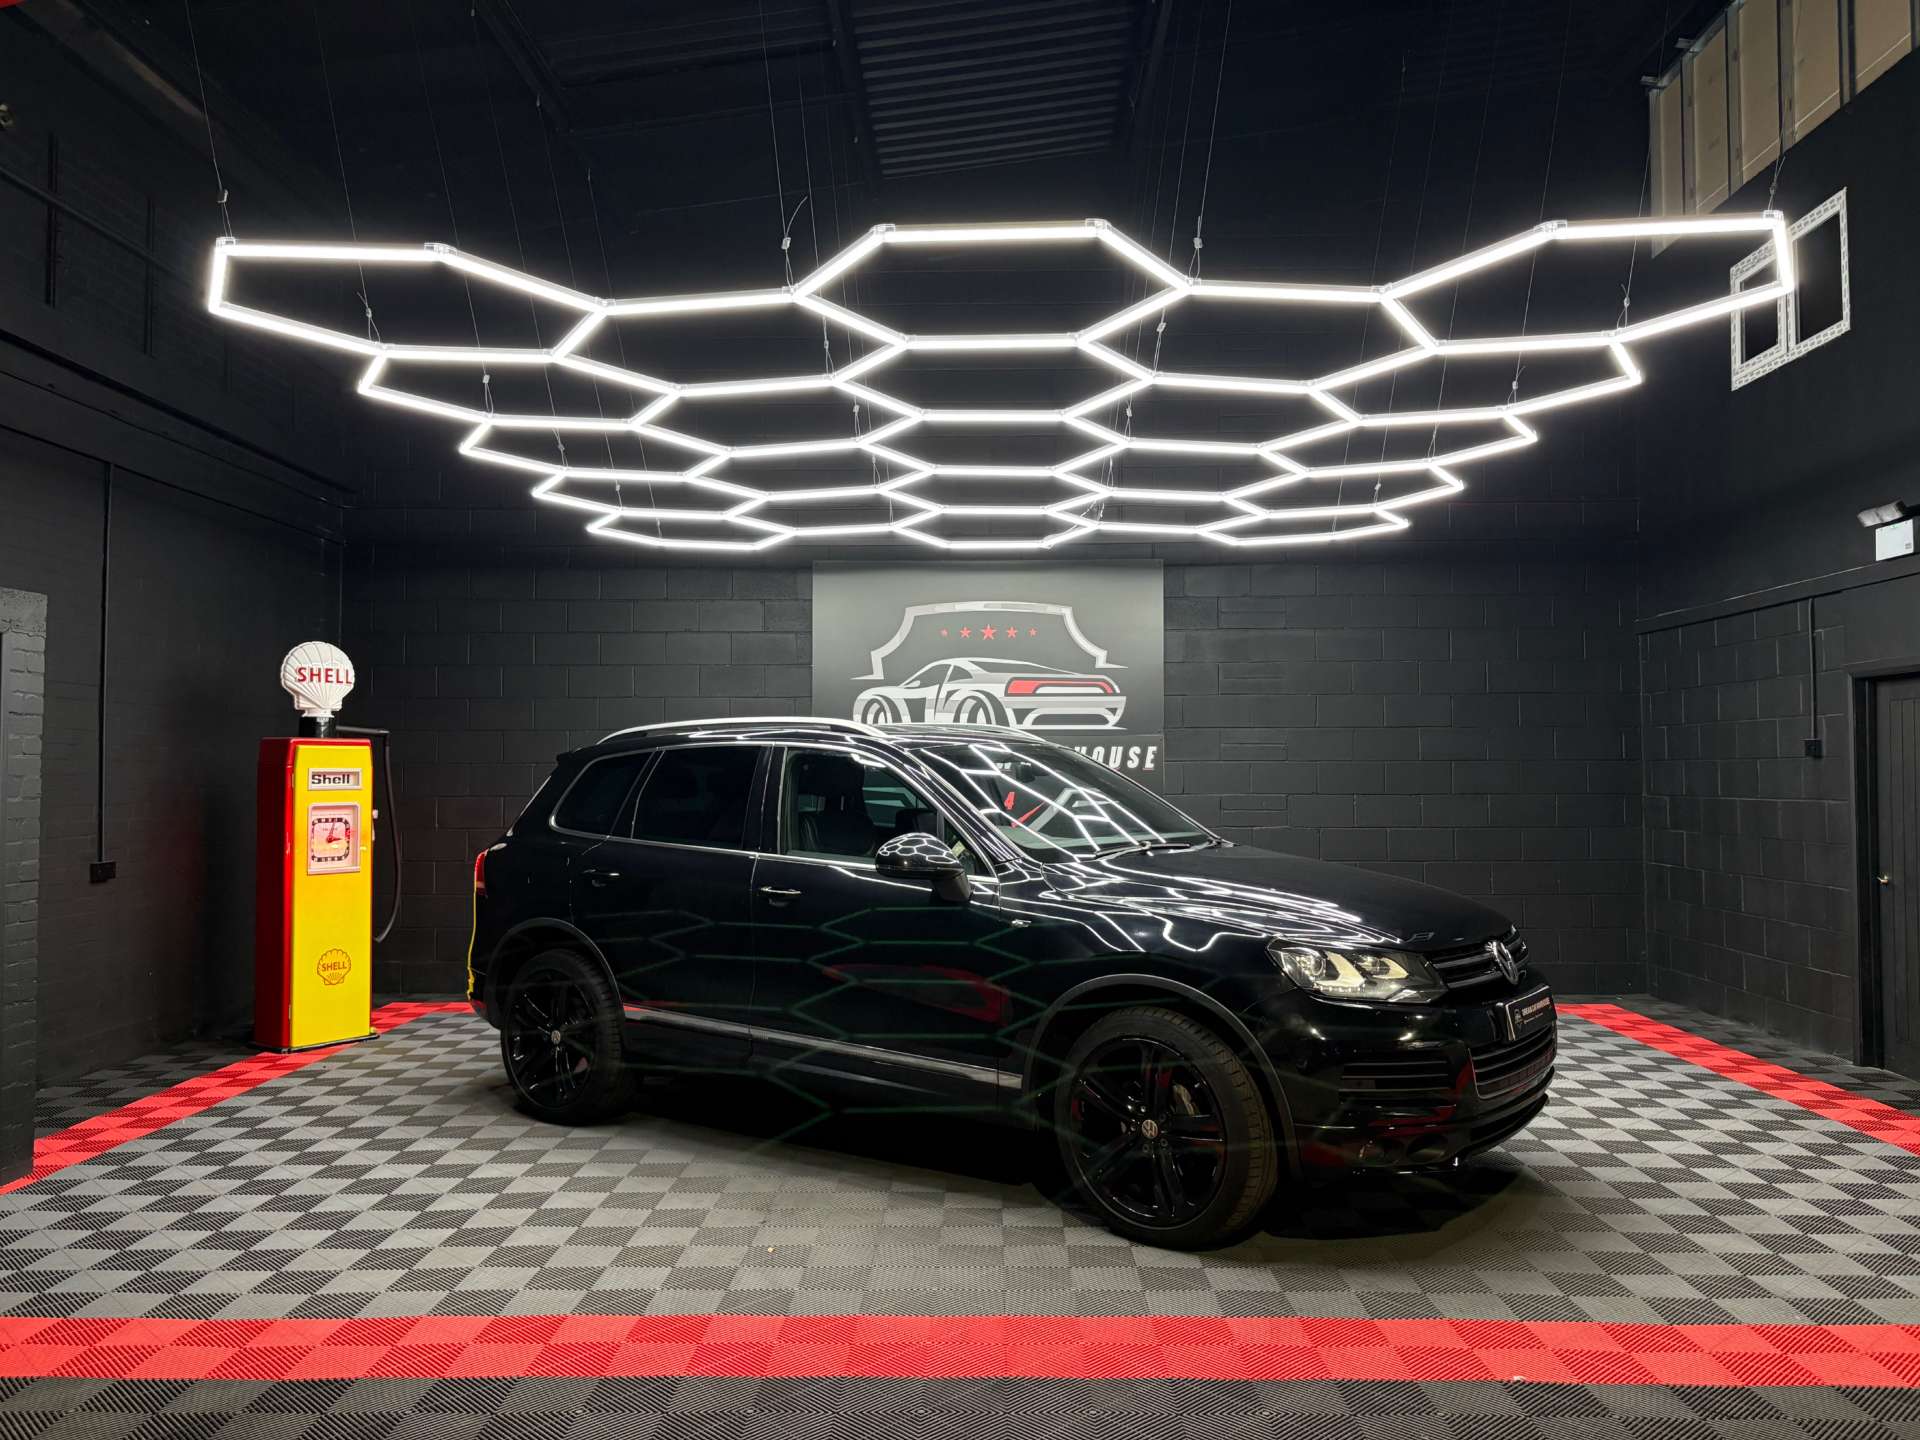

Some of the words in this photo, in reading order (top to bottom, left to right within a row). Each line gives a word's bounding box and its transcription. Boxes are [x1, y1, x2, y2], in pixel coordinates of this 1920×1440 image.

[297, 666, 352, 685] SHELL
[311, 773, 350, 785] Shell
[321, 961, 347, 972] SHELL
